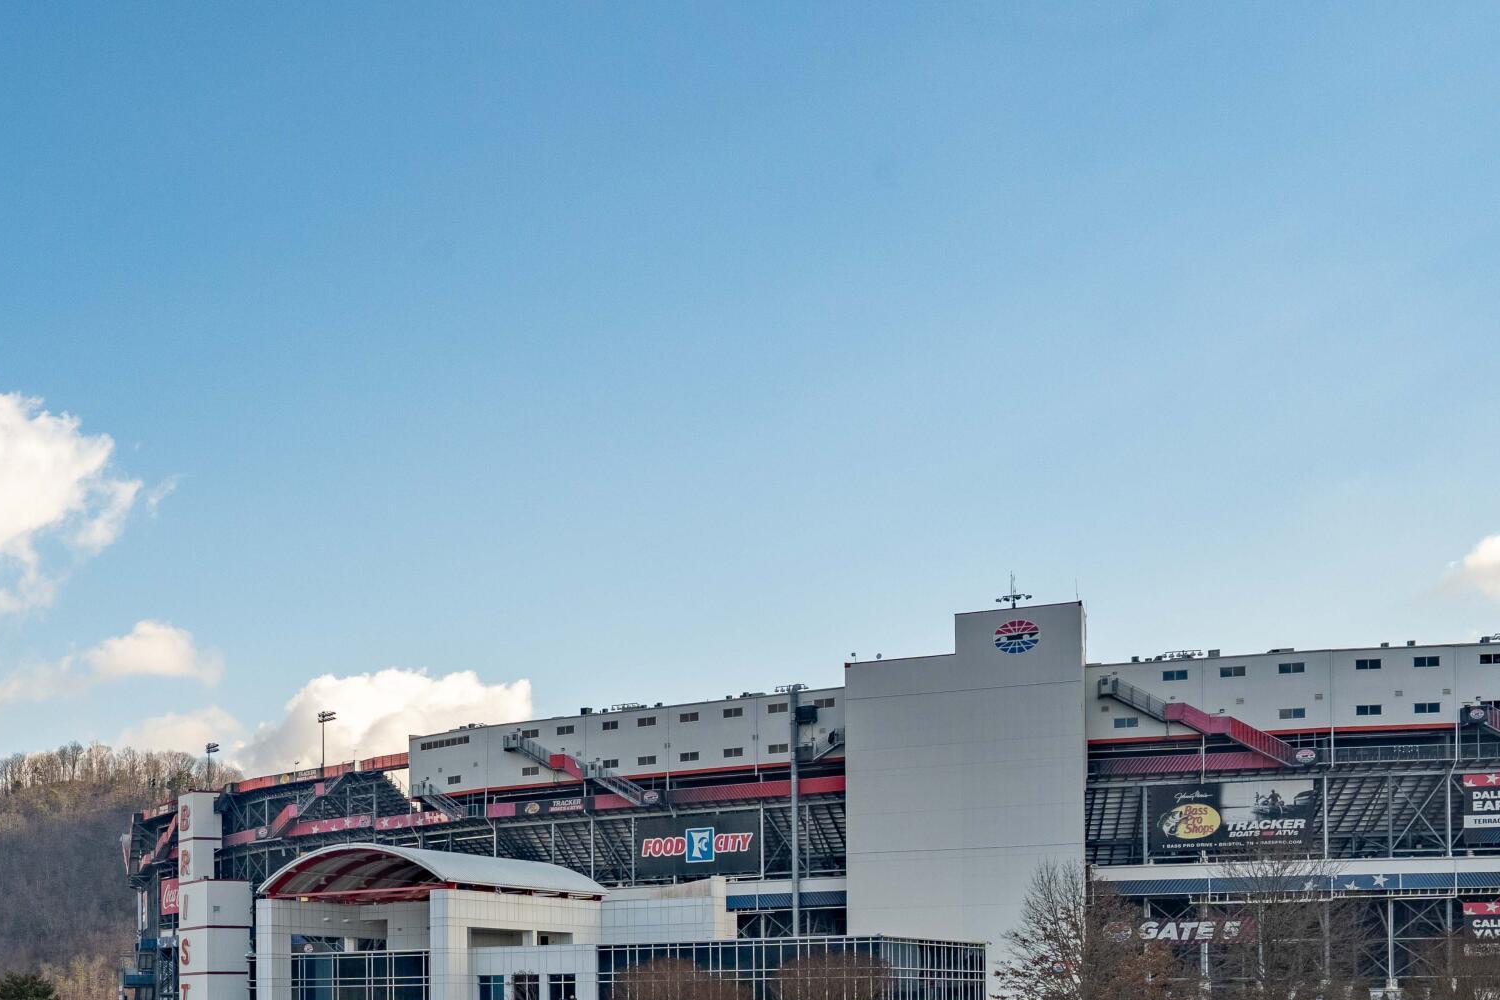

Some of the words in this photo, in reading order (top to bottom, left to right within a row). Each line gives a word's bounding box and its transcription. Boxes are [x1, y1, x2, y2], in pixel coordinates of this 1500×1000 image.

[1184, 806, 1208, 816] Bass
[1186, 815, 1203, 825] Pro
[1226, 819, 1306, 831] TRACKER
[1184, 823, 1214, 834] Shops
[1229, 830, 1260, 838] BOATS
[642, 837, 687, 857] FOOD
[714, 832, 754, 853] CITY
[1139, 920, 1216, 941] GATE
[1223, 920, 1241, 940] 5
